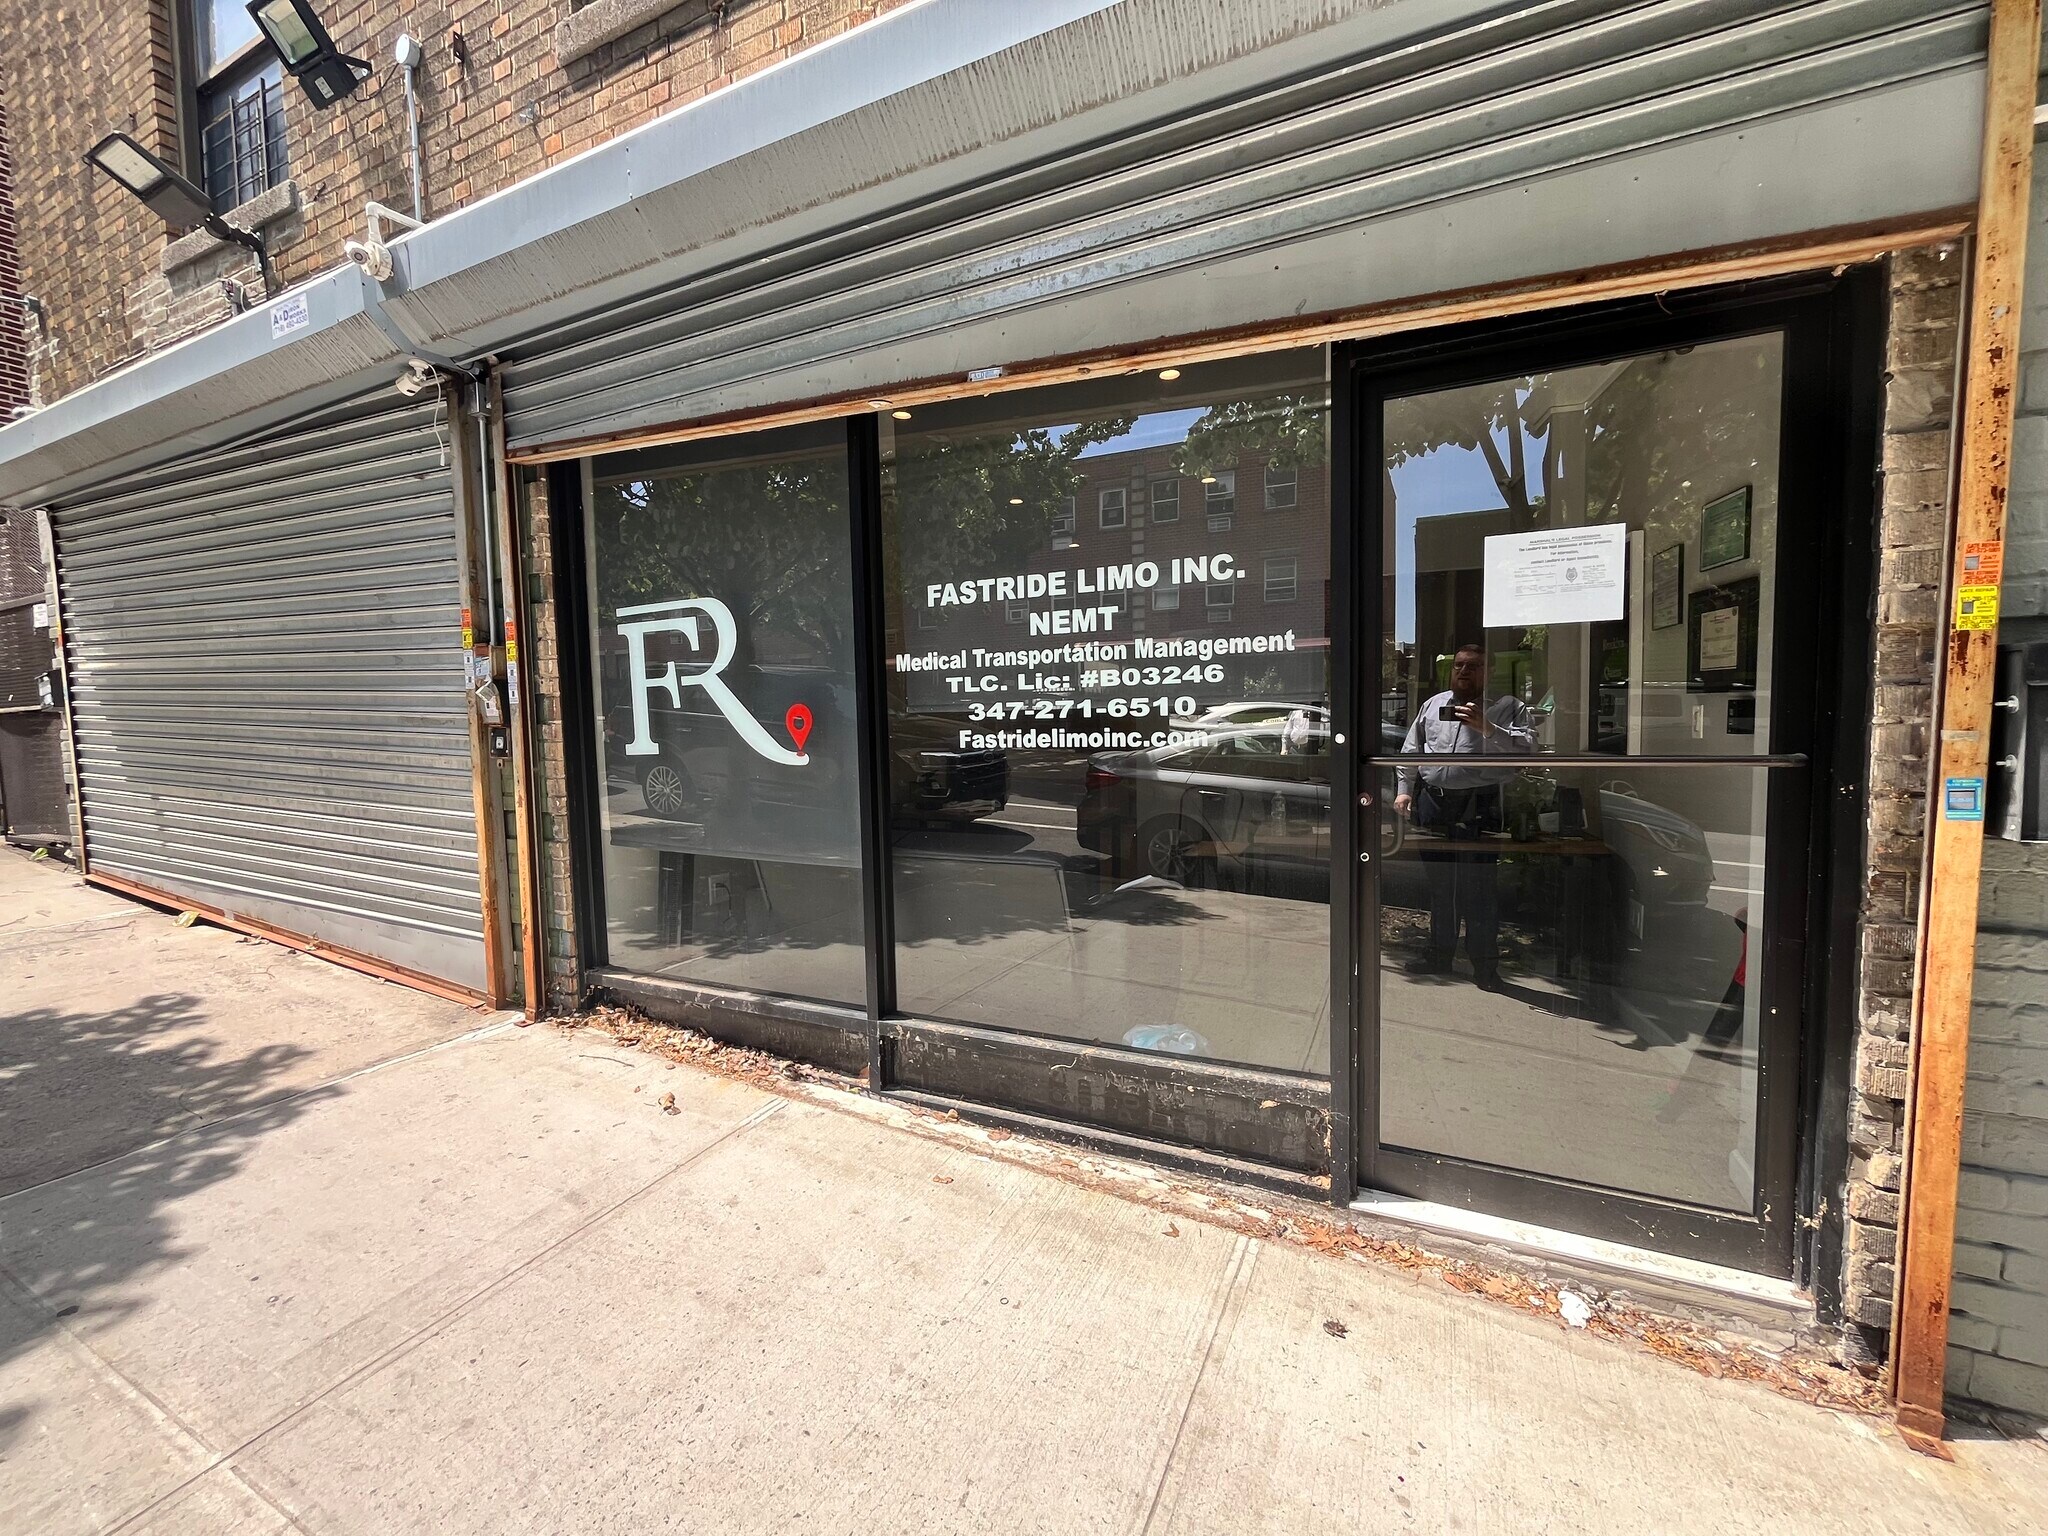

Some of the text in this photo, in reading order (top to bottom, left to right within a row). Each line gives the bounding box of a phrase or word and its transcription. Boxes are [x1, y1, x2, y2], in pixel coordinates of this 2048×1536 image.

[928, 553, 1246, 608] FASTRIDE LIMO INC.
[1029, 605, 1119, 636] NEMT
[896, 629, 1296, 672] Medical Transportation Management
[945, 664, 1225, 693] TLC. Lic: #B03246
[968, 696, 1197, 721] 347-271-6510
[959, 728, 1210, 749] Fastridelimoinc.com
